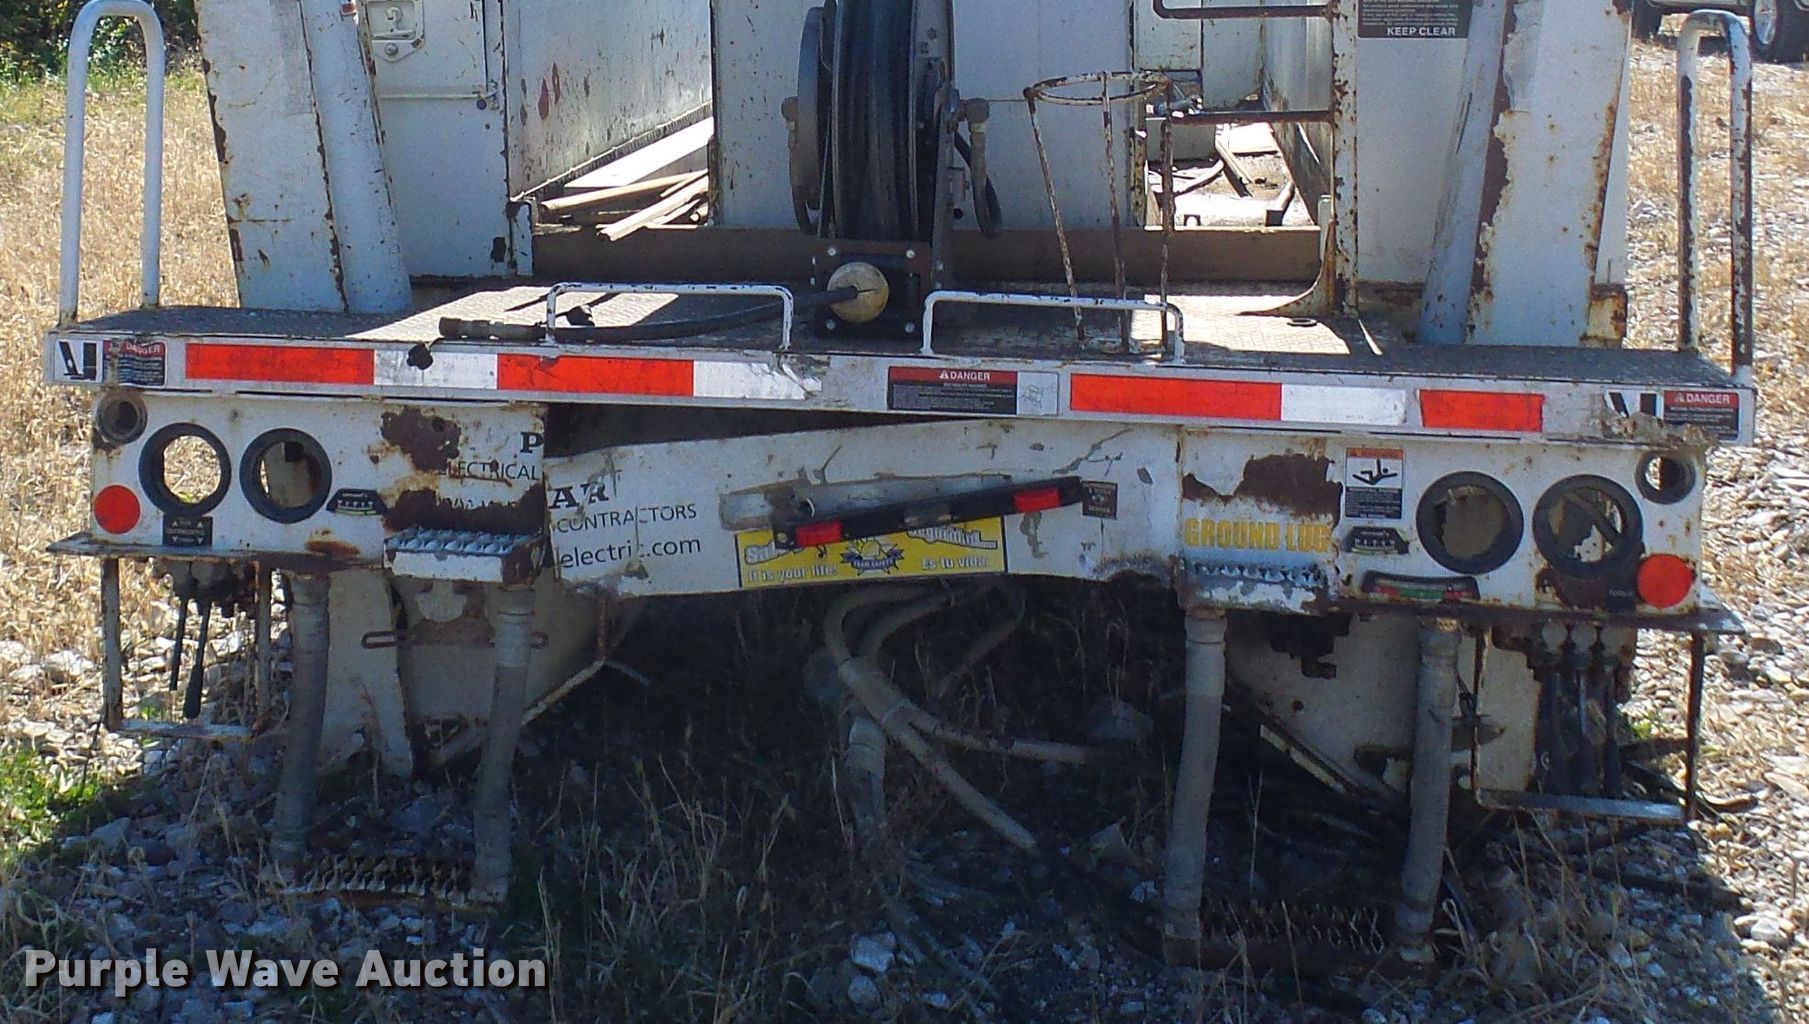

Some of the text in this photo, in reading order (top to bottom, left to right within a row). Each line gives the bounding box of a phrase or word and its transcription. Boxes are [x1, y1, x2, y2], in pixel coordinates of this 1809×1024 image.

[1387, 27, 1456, 36] KEEP CLEAR
[126, 343, 161, 354] DANGER
[950, 372, 990, 381] DANGER
[1686, 393, 1730, 404] DANGER
[1185, 518, 1329, 553] GROUND LUG
[778, 567, 805, 584] your
